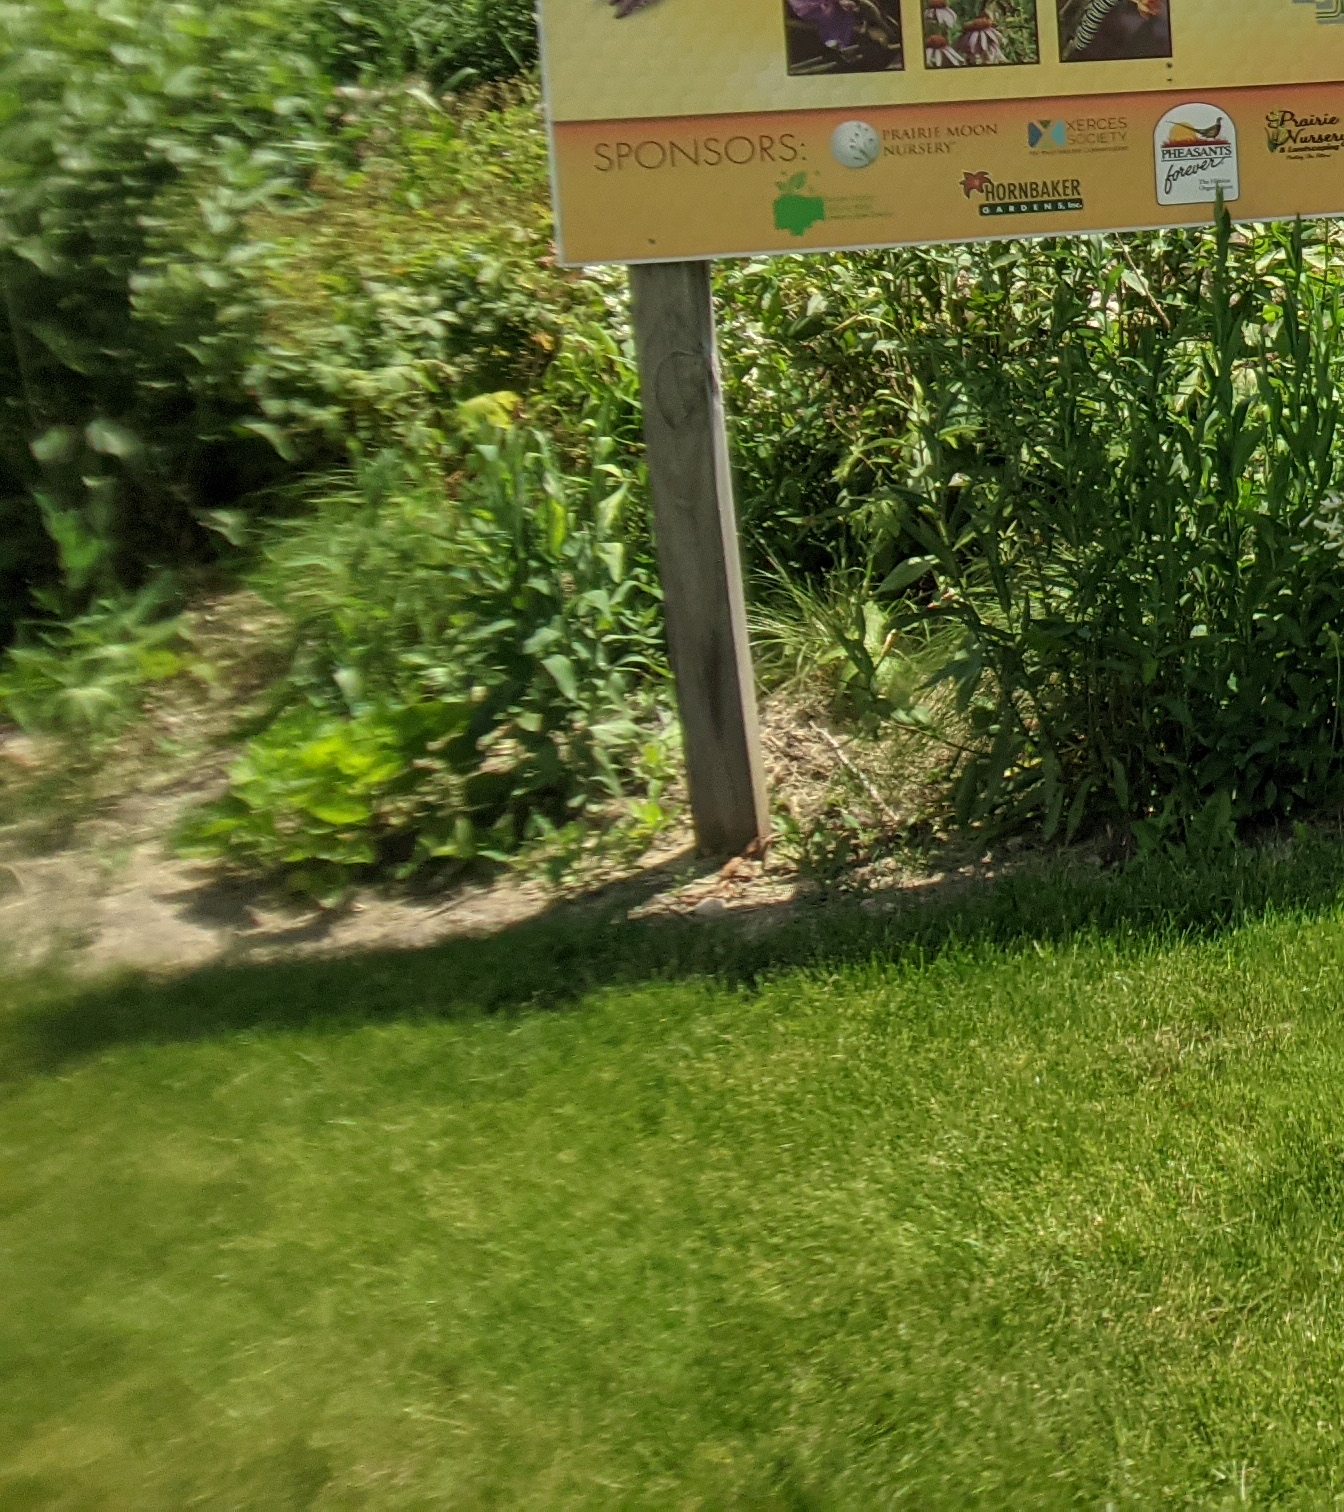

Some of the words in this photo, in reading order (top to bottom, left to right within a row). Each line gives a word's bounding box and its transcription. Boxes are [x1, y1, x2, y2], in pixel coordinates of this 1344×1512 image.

[1066, 116, 1129, 132] XERCES
[1266, 109, 1341, 128] Prairie
[882, 126, 941, 142] PRAIRIE
[947, 123, 999, 138] MOON
[1067, 130, 1129, 145] SOCIETY
[592, 132, 808, 172] SPONSORS:
[1161, 145, 1233, 160] PHEASANTS
[1164, 156, 1226, 195] forever
[984, 178, 1082, 202] HORNBAKER
